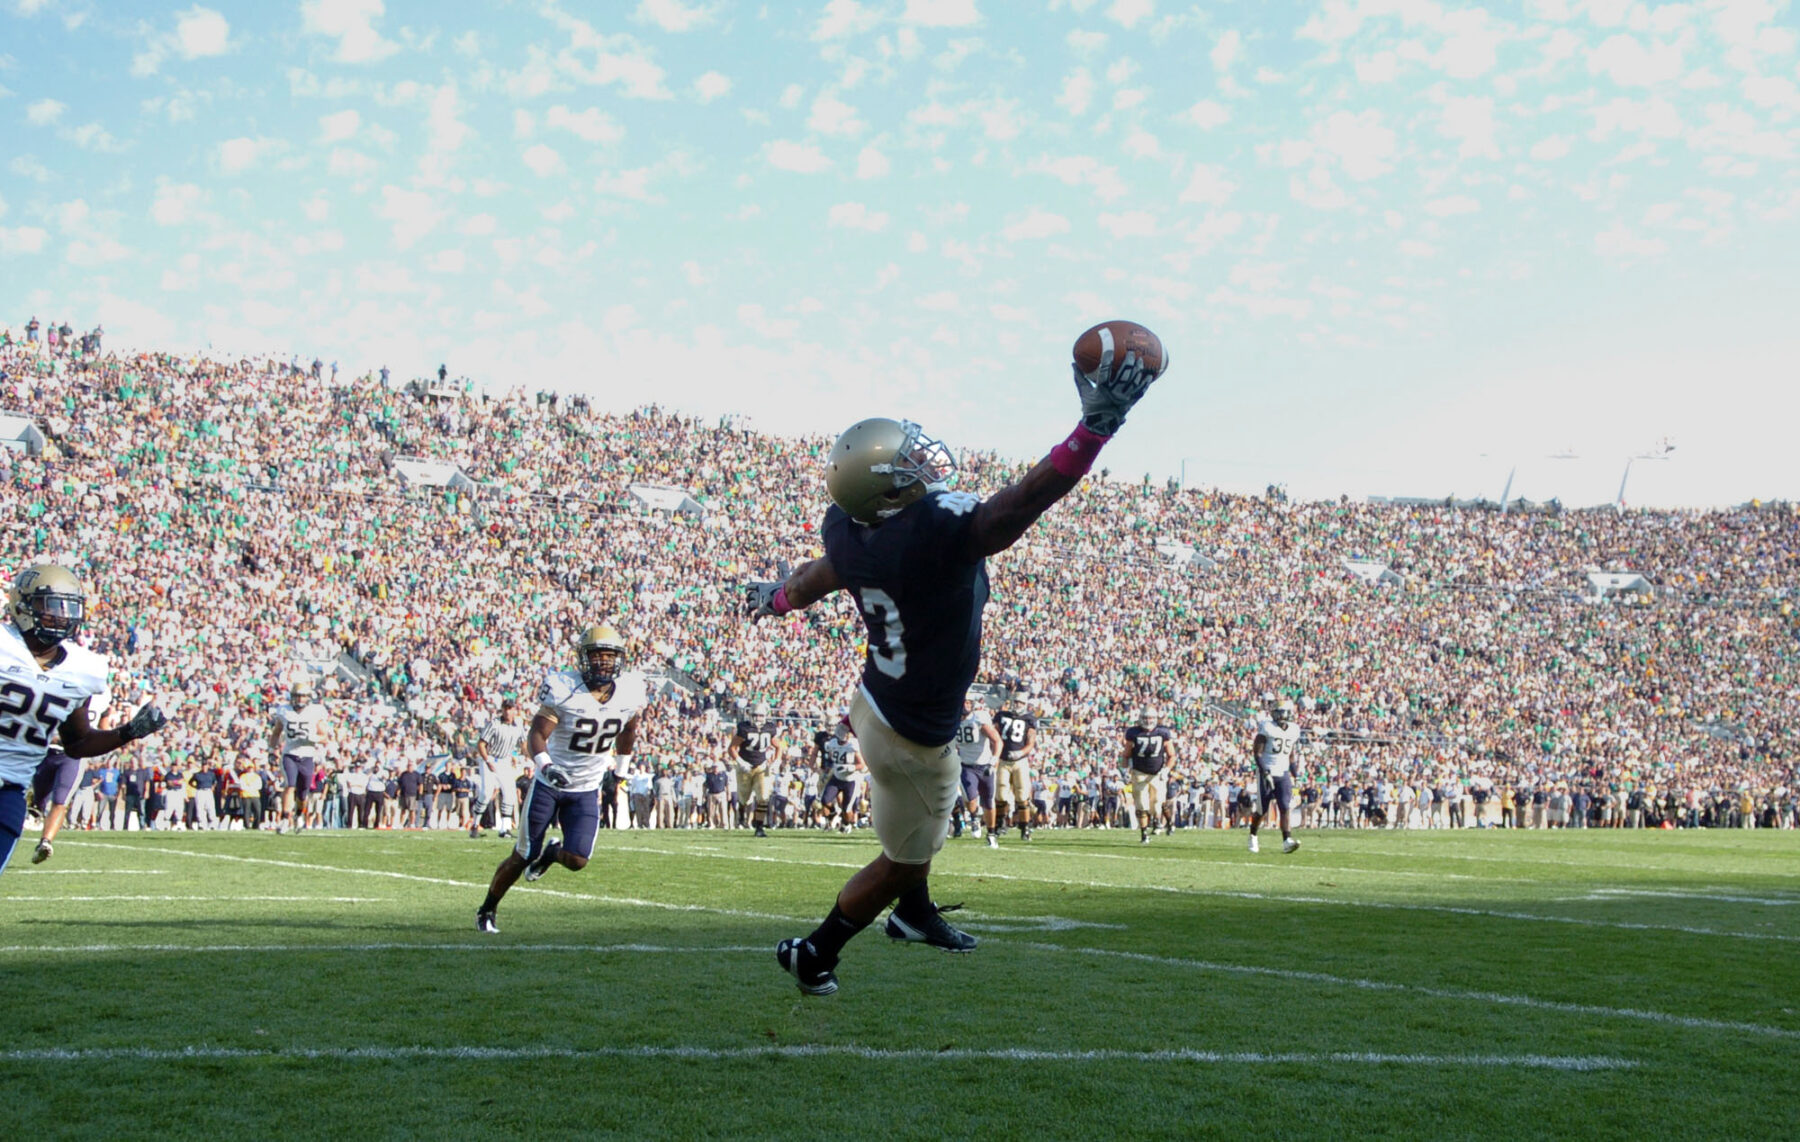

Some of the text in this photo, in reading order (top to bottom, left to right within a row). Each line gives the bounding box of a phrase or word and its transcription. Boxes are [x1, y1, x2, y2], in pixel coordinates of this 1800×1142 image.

[860, 587, 907, 680] 3
[0, 682, 69, 747] 25
[287, 721, 309, 738] 55
[568, 718, 622, 754] 22
[745, 732, 771, 752] 70
[1001, 716, 1025, 742] 78
[1136, 735, 1163, 757] 77
